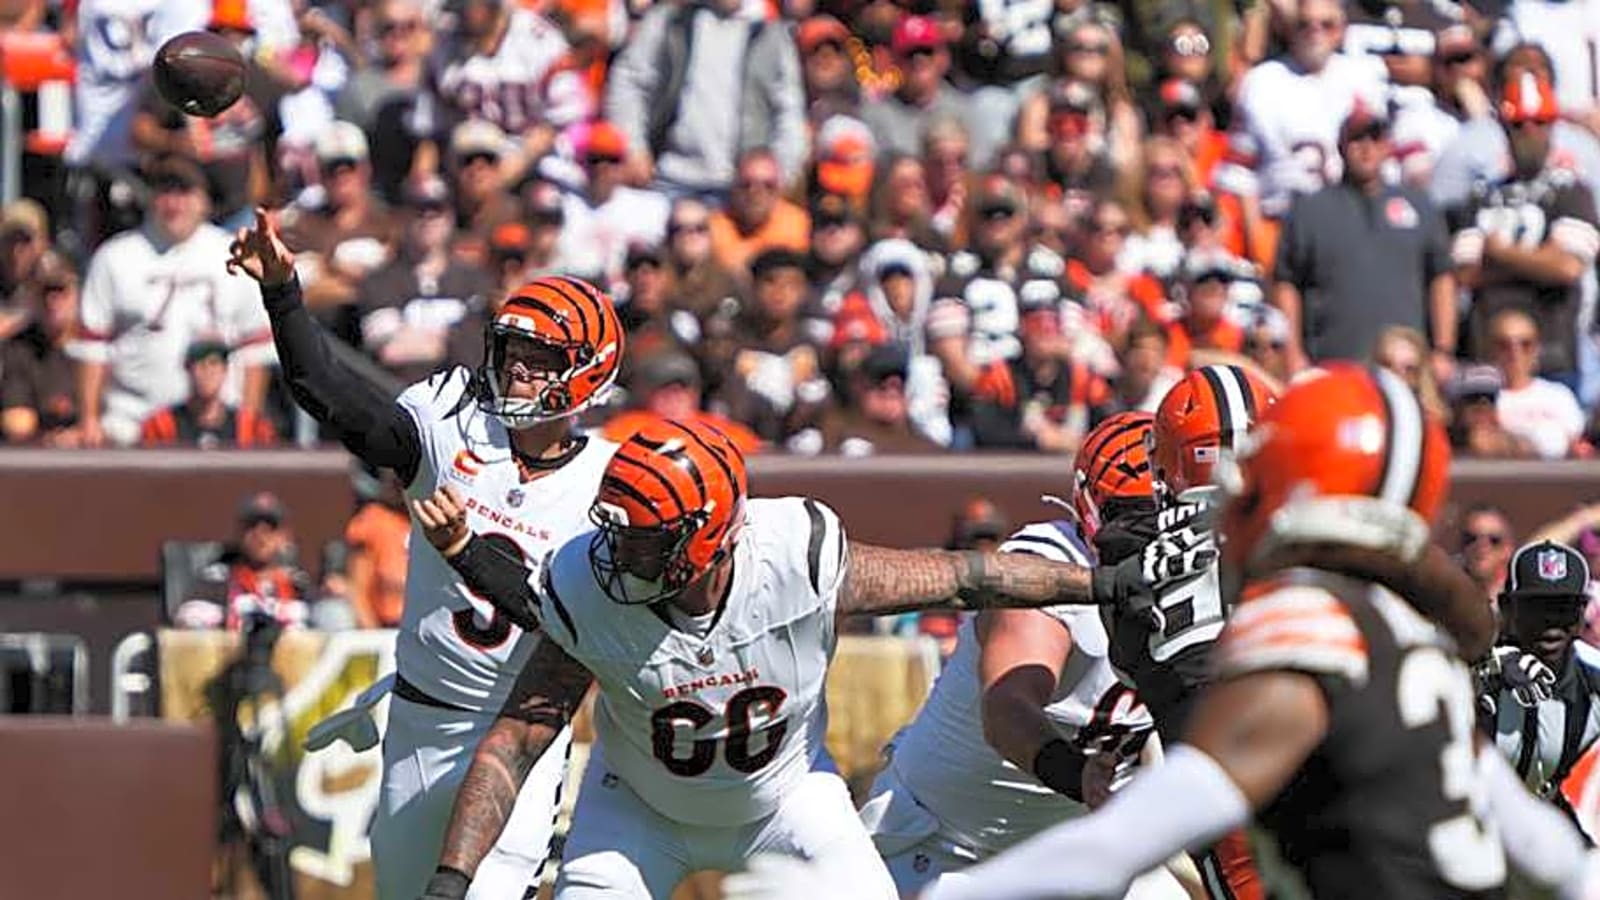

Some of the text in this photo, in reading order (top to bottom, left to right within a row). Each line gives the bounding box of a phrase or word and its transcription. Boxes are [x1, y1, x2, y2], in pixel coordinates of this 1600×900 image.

[465, 497, 551, 541] BENGALS
[662, 666, 760, 698] BENGALS
[651, 685, 788, 778] 66
